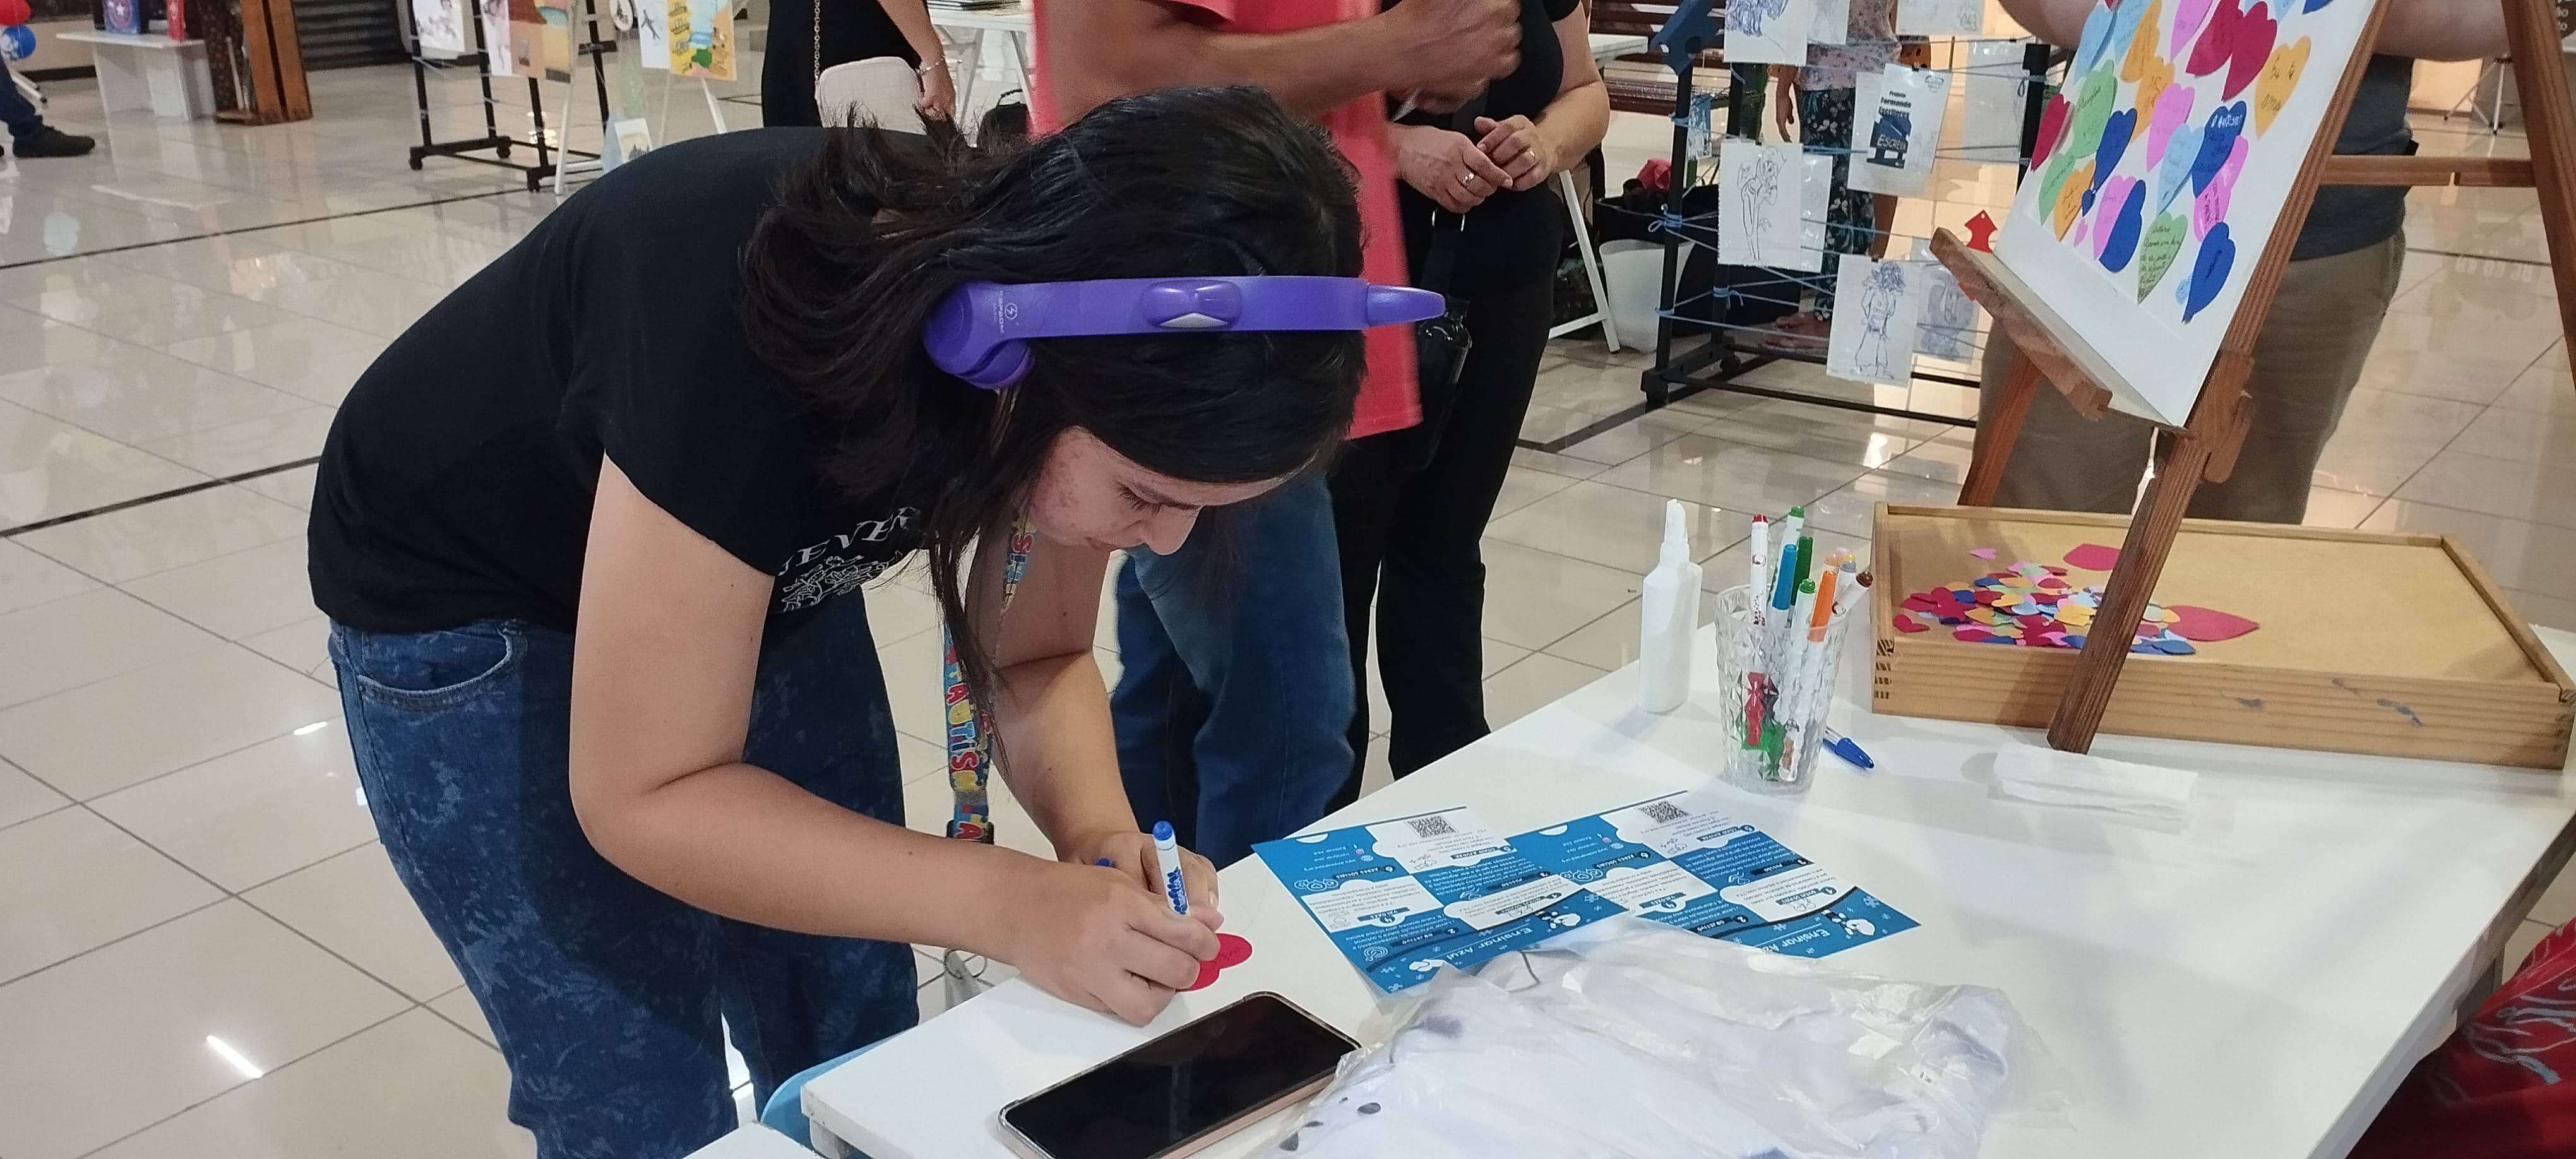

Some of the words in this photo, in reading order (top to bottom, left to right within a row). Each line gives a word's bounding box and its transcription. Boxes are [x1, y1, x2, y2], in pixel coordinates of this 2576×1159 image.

[1880, 97, 1912, 108] Formando
[1478, 927, 1533, 949] Ensinar
[1782, 929, 1830, 947] Ensinar
[1446, 947, 1474, 960] Azul
